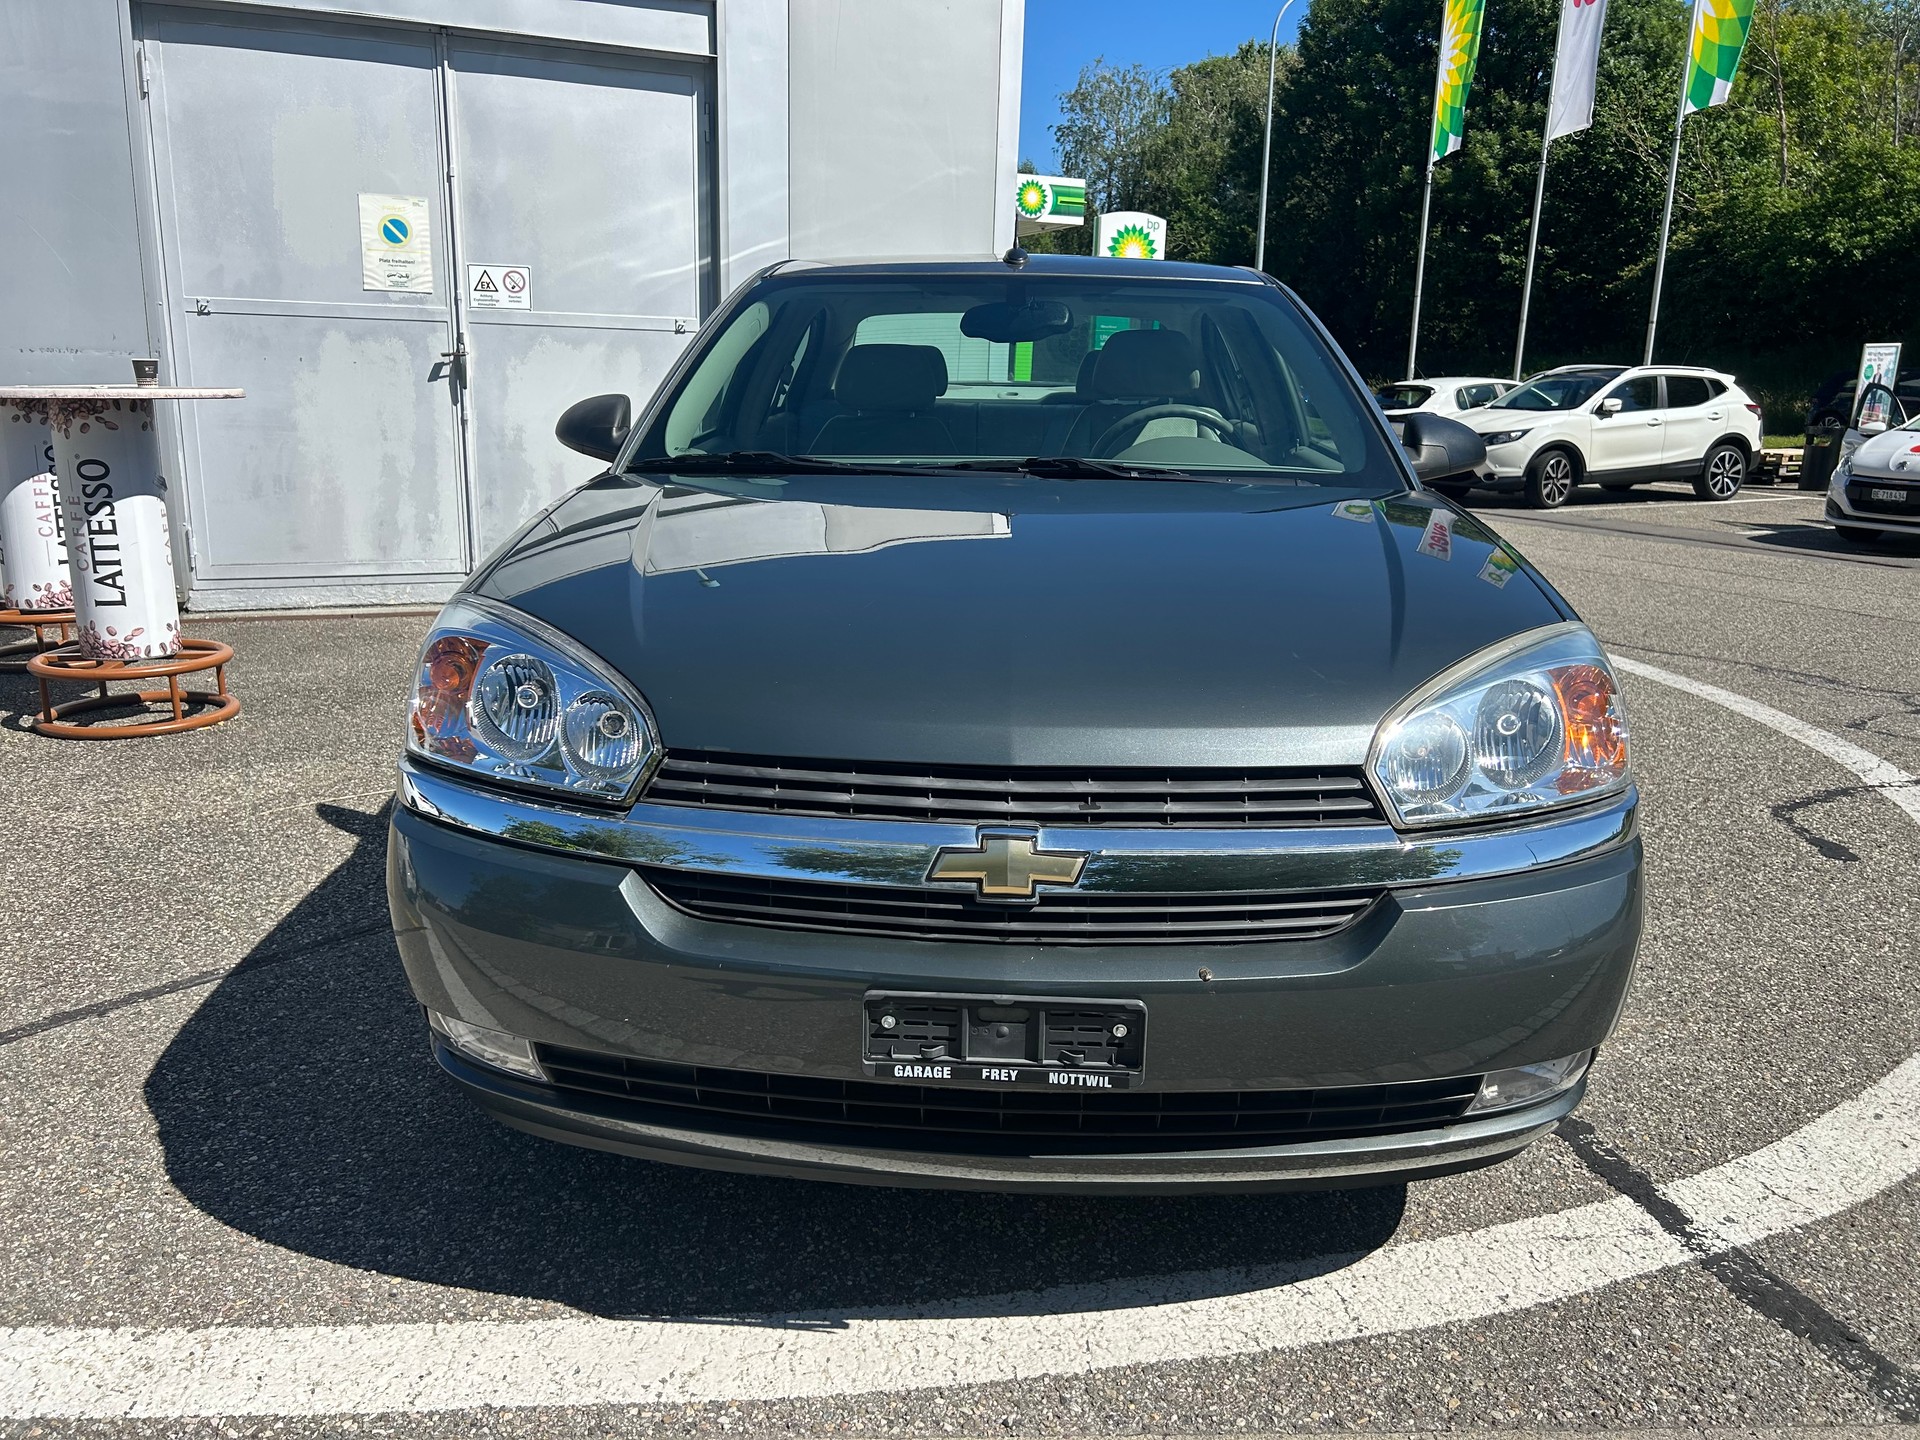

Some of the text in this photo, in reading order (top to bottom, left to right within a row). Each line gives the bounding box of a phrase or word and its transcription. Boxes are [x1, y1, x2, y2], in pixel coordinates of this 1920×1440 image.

[1147, 218, 1160, 232] bp
[481, 281, 491, 290] EX
[65, 495, 90, 572] CAFFÈ
[76, 458, 127, 608] LATTESSO
[894, 1065, 1113, 1088] GARAGE FREY NOTTWIL
